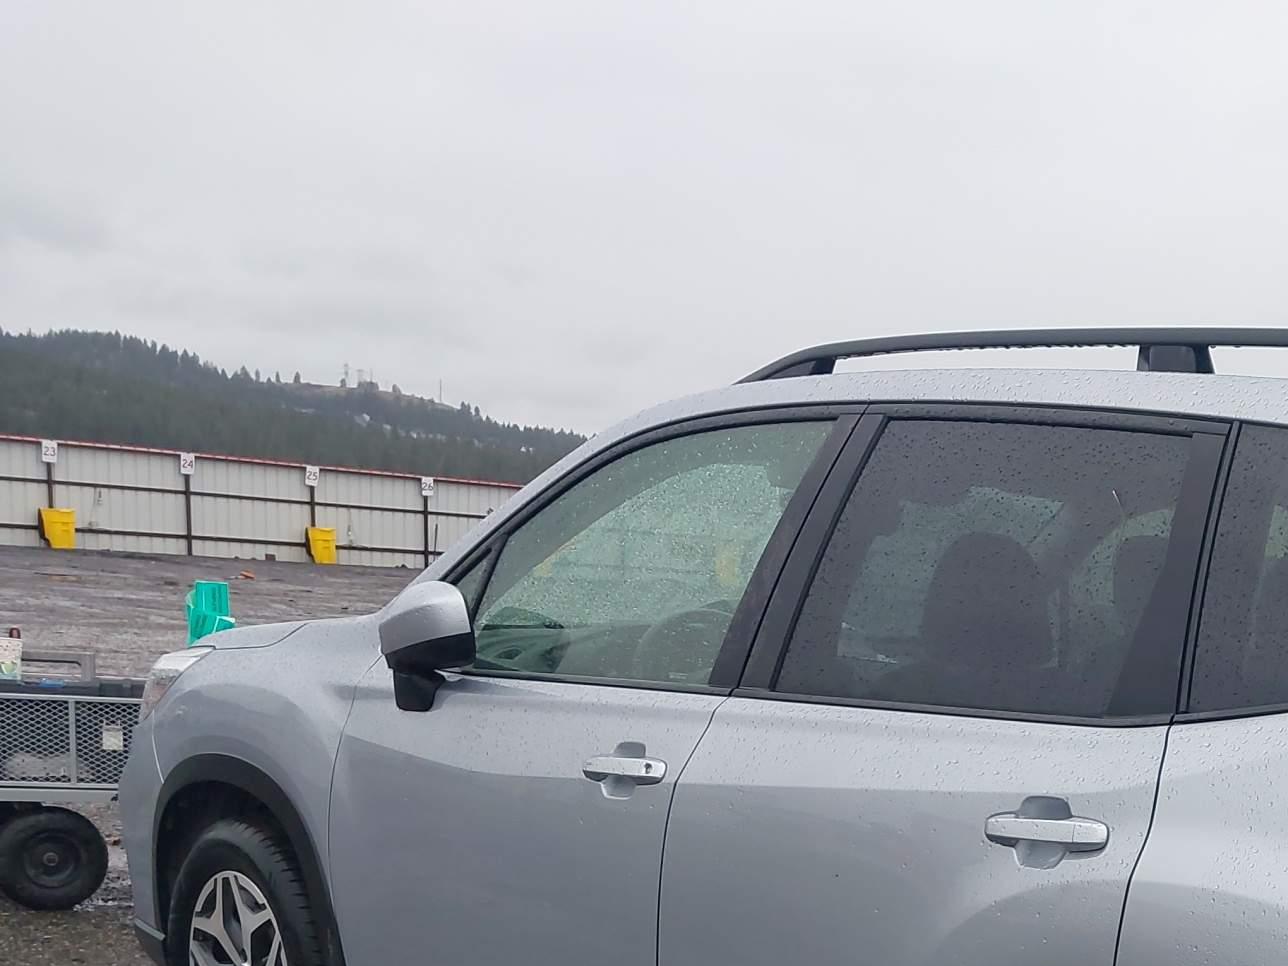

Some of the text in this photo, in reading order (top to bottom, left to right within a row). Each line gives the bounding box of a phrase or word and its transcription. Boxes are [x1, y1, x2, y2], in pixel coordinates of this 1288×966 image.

[43, 446, 56, 456] 23
[182, 458, 193, 468] 24
[307, 471, 318, 481] 25
[422, 482, 434, 491] 26
